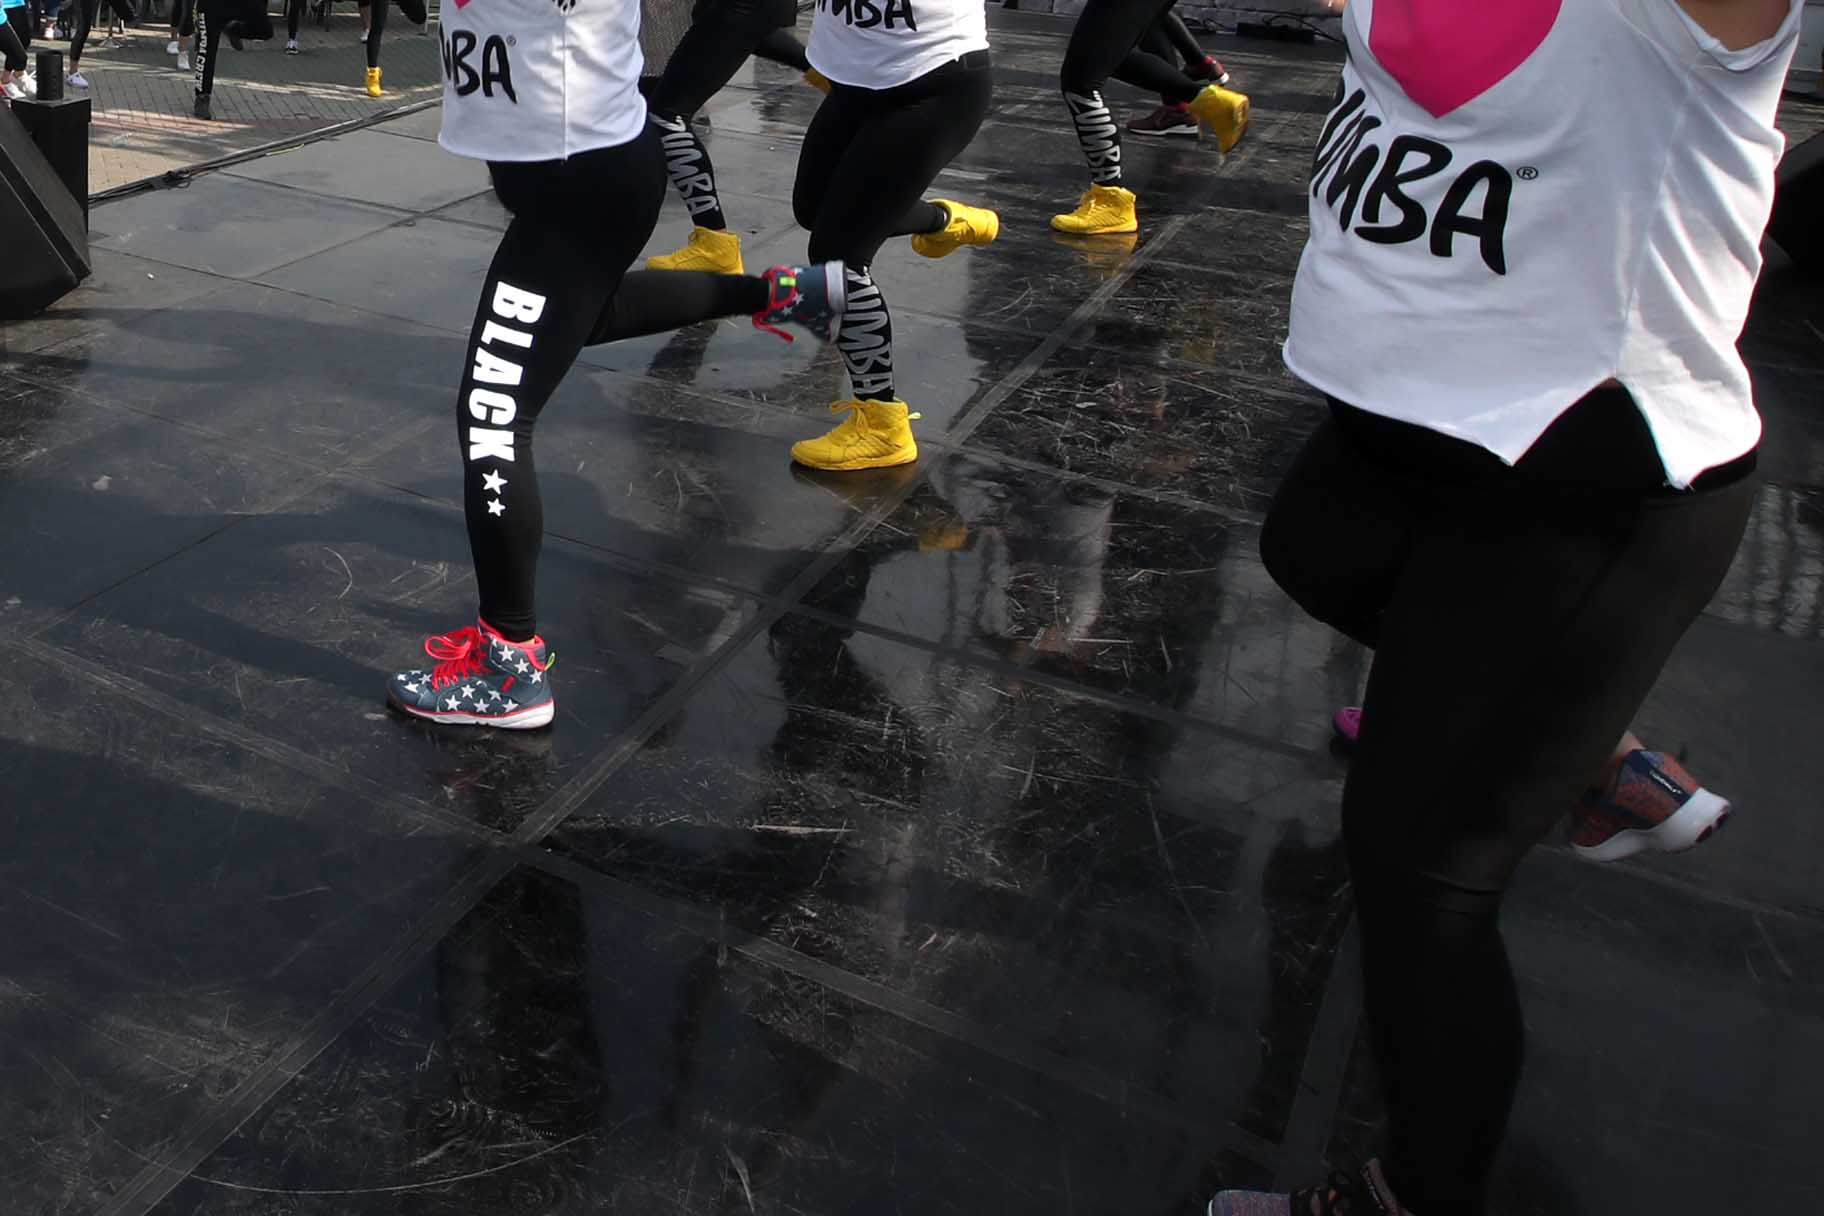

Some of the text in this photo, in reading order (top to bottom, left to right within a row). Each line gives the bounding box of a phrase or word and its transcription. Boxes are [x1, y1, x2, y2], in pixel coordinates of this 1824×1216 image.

[650, 115, 718, 216] ZUMBA
[1065, 89, 1121, 182] ZUMBA
[468, 280, 547, 462] BLACK
